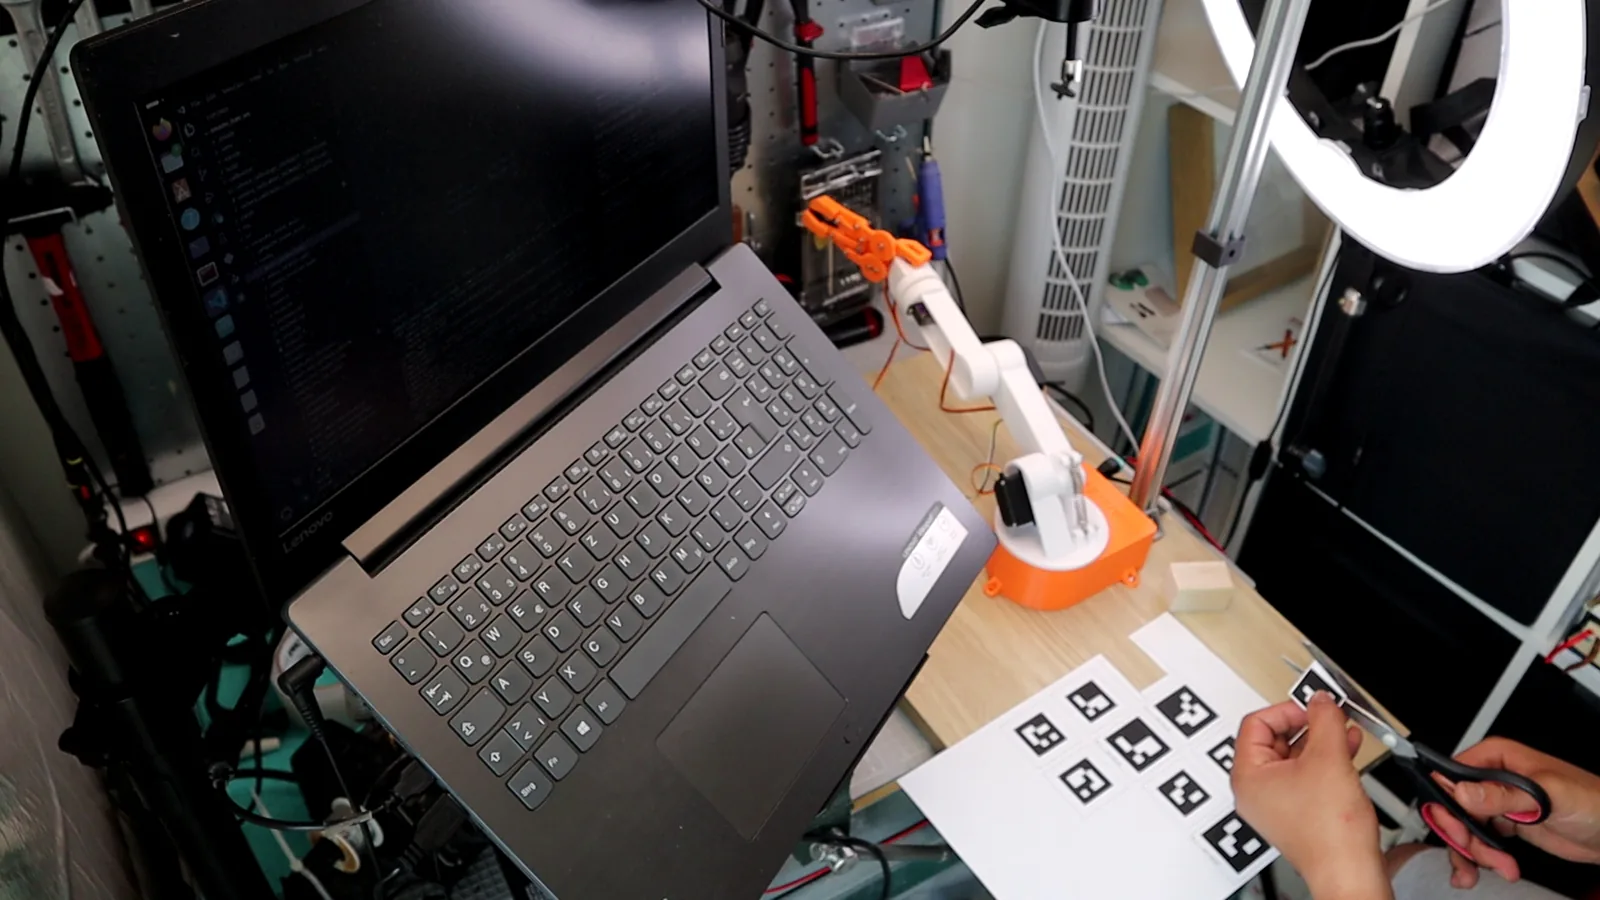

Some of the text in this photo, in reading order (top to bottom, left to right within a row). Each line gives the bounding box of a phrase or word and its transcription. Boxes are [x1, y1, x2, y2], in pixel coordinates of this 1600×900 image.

[654, 440, 662, 449] 0
[633, 459, 642, 468] 9
[671, 455, 679, 466] P
[612, 479, 621, 488] 8
[652, 473, 662, 484] O
[589, 499, 598, 508] 7
[681, 496, 692, 504] L
[608, 513, 619, 524] U
[661, 513, 673, 524] K
[567, 520, 576, 530] 6
[282, 511, 333, 554] Lenovo
[586, 535, 598, 547] Z
[642, 534, 651, 545] J
[543, 542, 553, 552] 5
[676, 548, 688, 560] M
[562, 557, 573, 568] T
[619, 555, 631, 567] H
[519, 565, 528, 575] 4
[655, 570, 667, 582] N
[538, 581, 550, 593] R
[597, 578, 608, 589] G
[492, 589, 502, 599] 3
[634, 594, 645, 605] B
[512, 605, 525, 617] E
[572, 601, 583, 613] F
[465, 614, 476, 625] 2
[611, 616, 622, 627] V
[486, 626, 501, 641] W
[548, 626, 560, 638] D
[379, 635, 392, 647] Esc
[438, 640, 447, 649] 1
[588, 641, 600, 652] C
[460, 656, 473, 667] Q
[523, 651, 535, 662] S
[563, 666, 576, 679] X
[498, 678, 510, 690] A
[538, 691, 550, 703] Y
[598, 702, 608, 712] Alt
[547, 757, 558, 768] Fn
[520, 782, 537, 797] Strg
